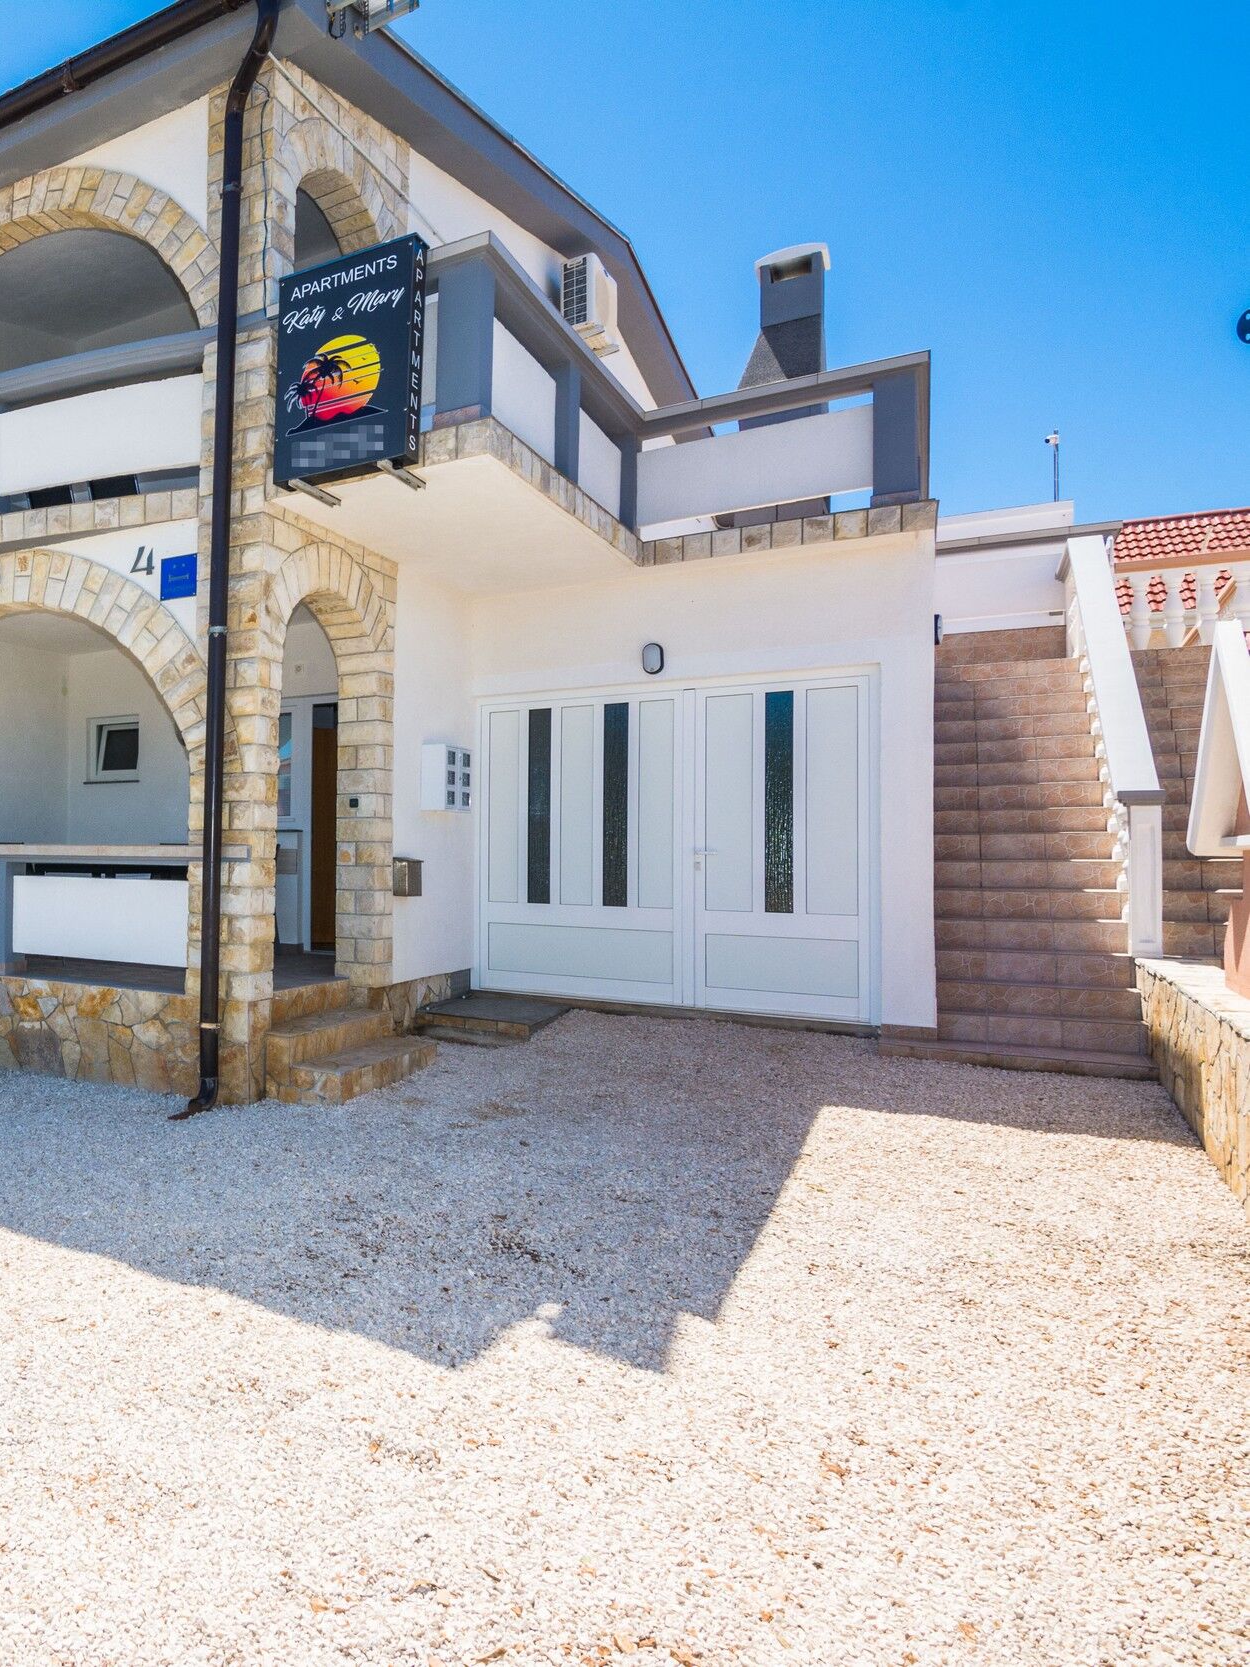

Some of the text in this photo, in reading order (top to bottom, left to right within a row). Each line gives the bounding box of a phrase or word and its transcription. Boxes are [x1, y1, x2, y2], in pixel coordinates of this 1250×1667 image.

[291, 254, 397, 301] APARTMENTS
[282, 287, 405, 333] Katy & Mary
[408, 248, 424, 451] APARTMENTS
[129, 546, 155, 575] 4
